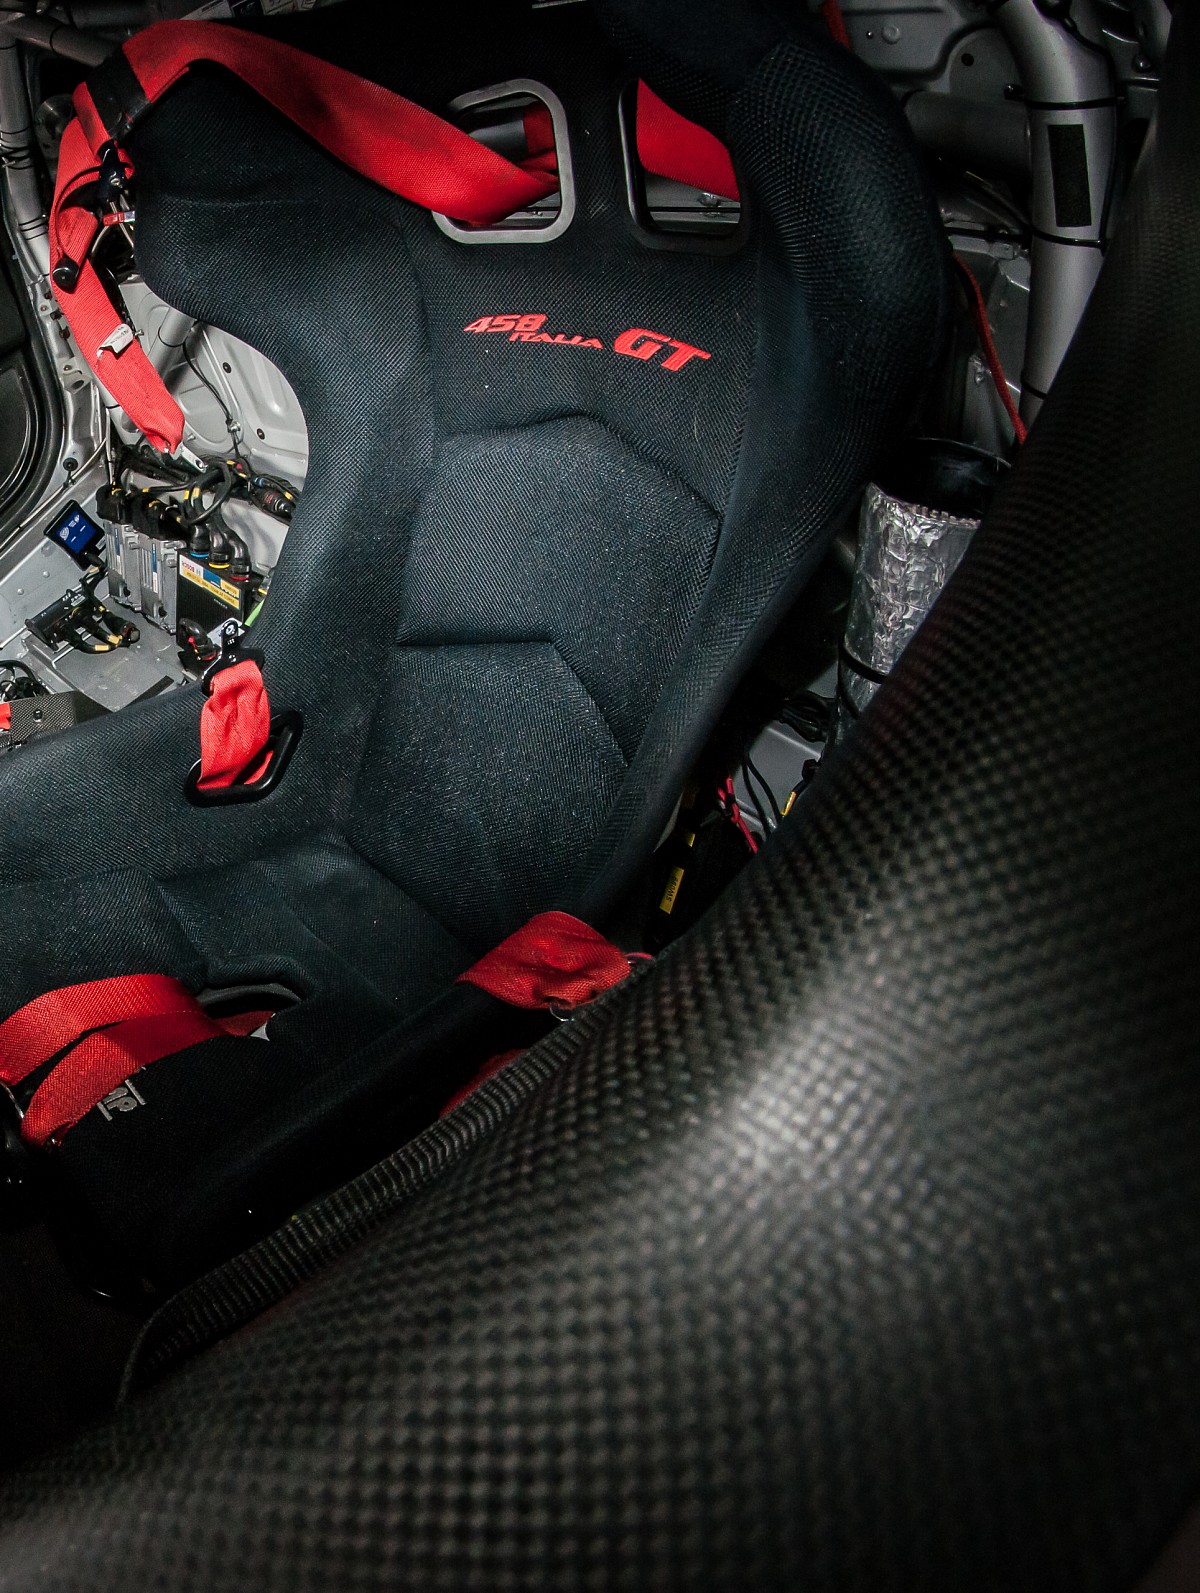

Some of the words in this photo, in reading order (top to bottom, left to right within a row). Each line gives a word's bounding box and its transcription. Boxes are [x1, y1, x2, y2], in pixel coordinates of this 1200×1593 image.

[463, 313, 547, 334] 458
[509, 331, 604, 349] ITALIA
[613, 327, 712, 372] GT
